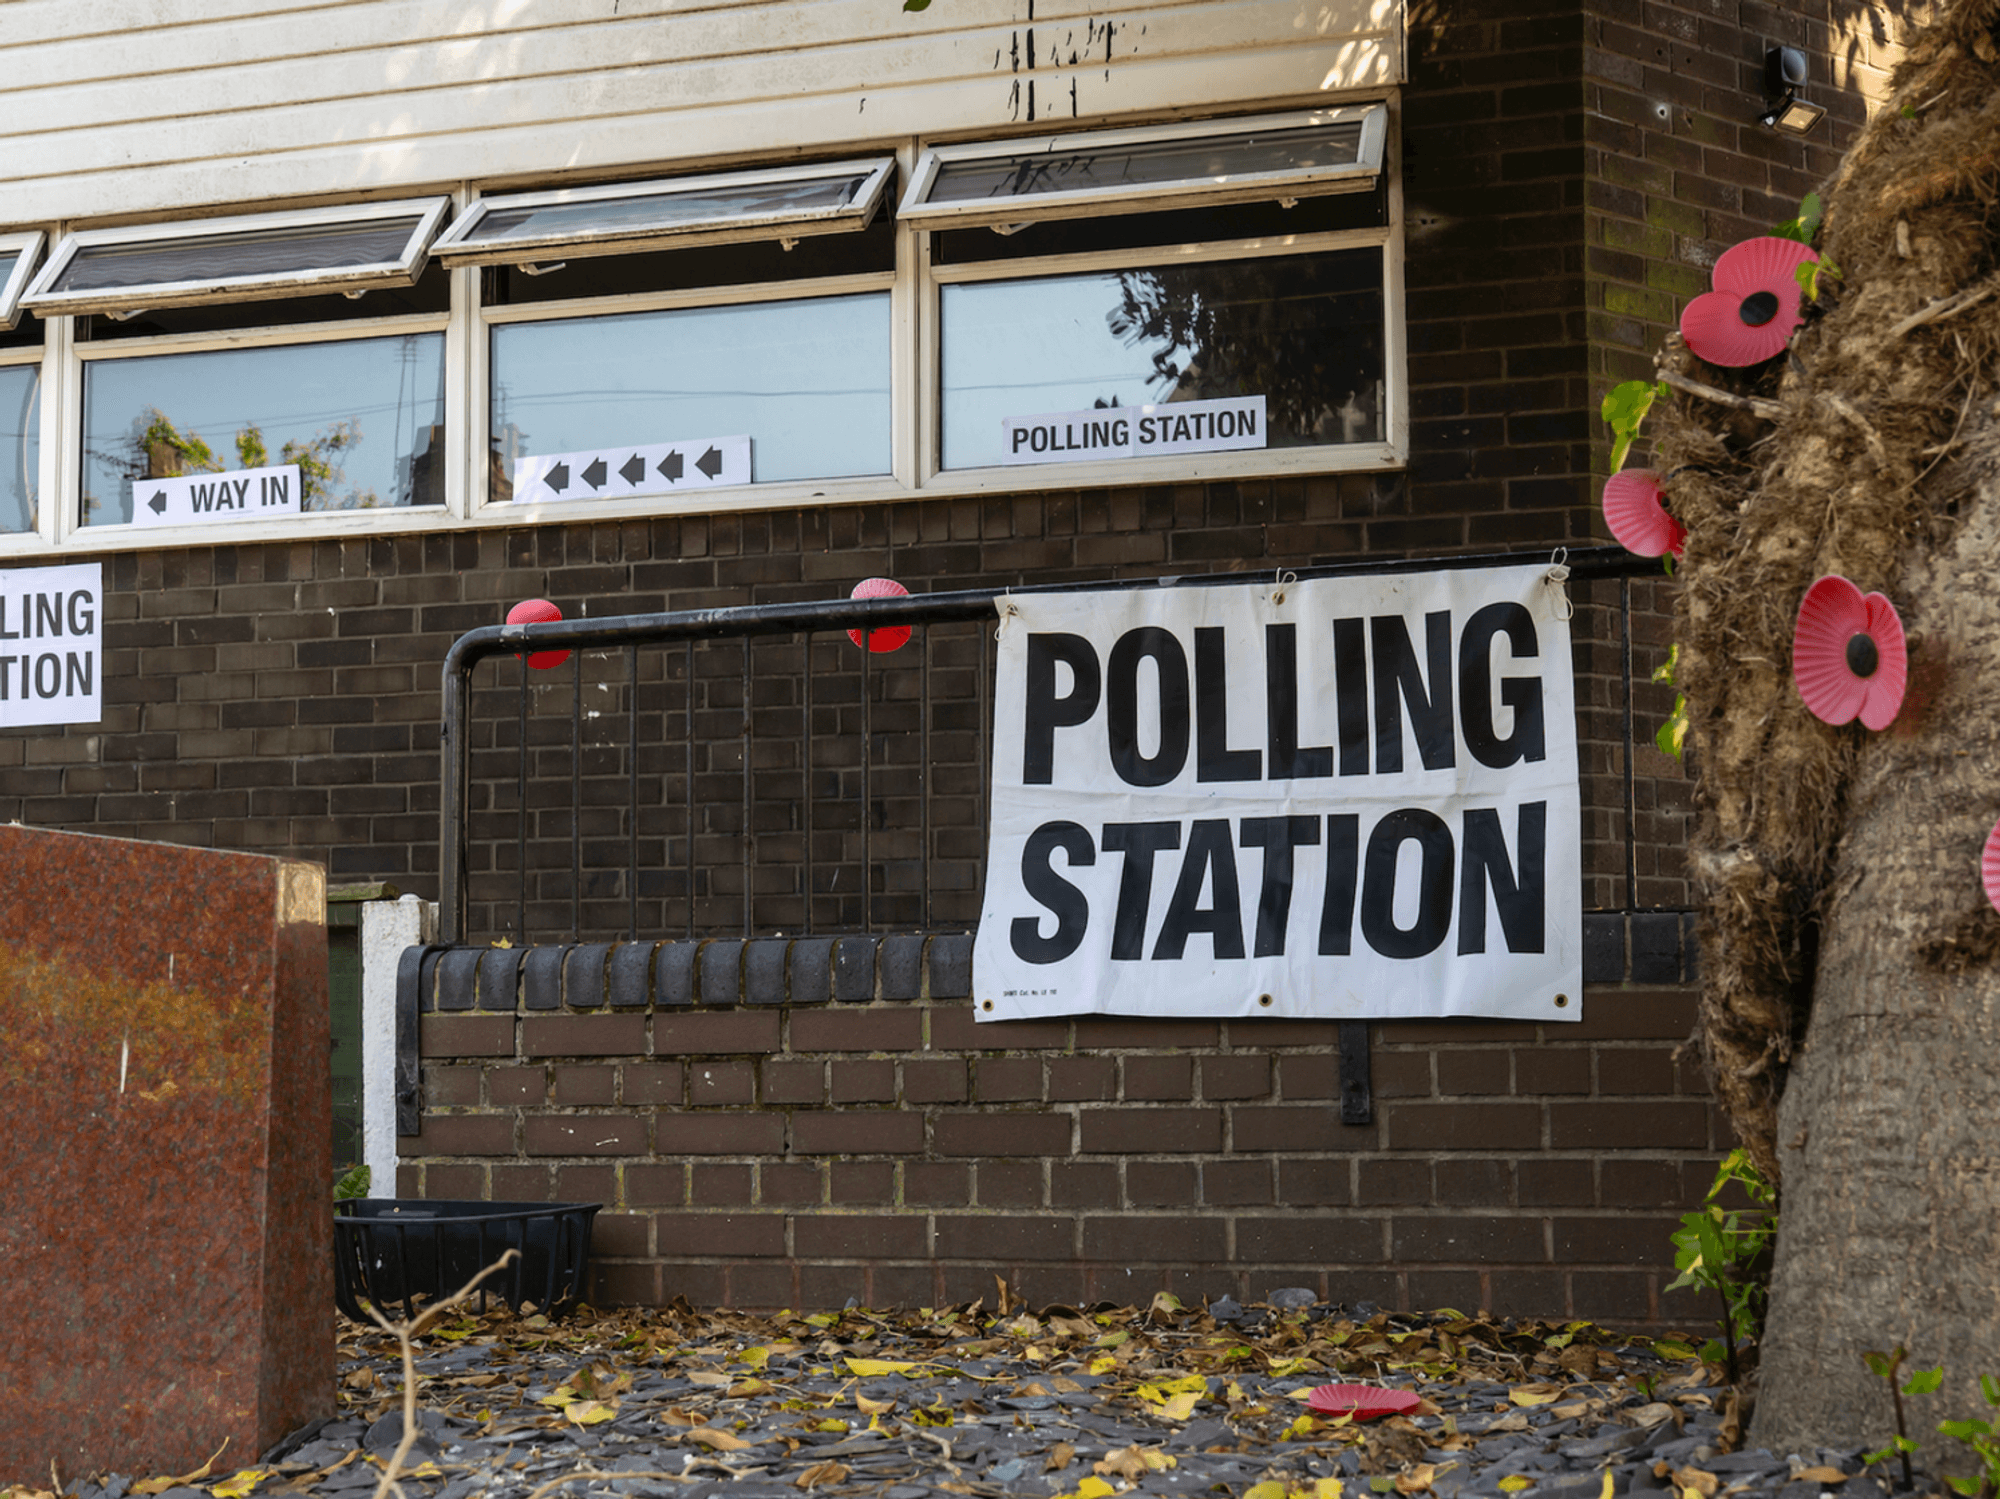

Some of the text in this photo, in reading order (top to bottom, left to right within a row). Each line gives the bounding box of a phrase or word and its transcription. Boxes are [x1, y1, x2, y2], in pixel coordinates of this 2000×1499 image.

[1012, 409, 1256, 454] POLLING STATION
[189, 475, 289, 513] WAY IN
[1022, 601, 1546, 788] POLLING
[1009, 800, 1547, 965] STATION
